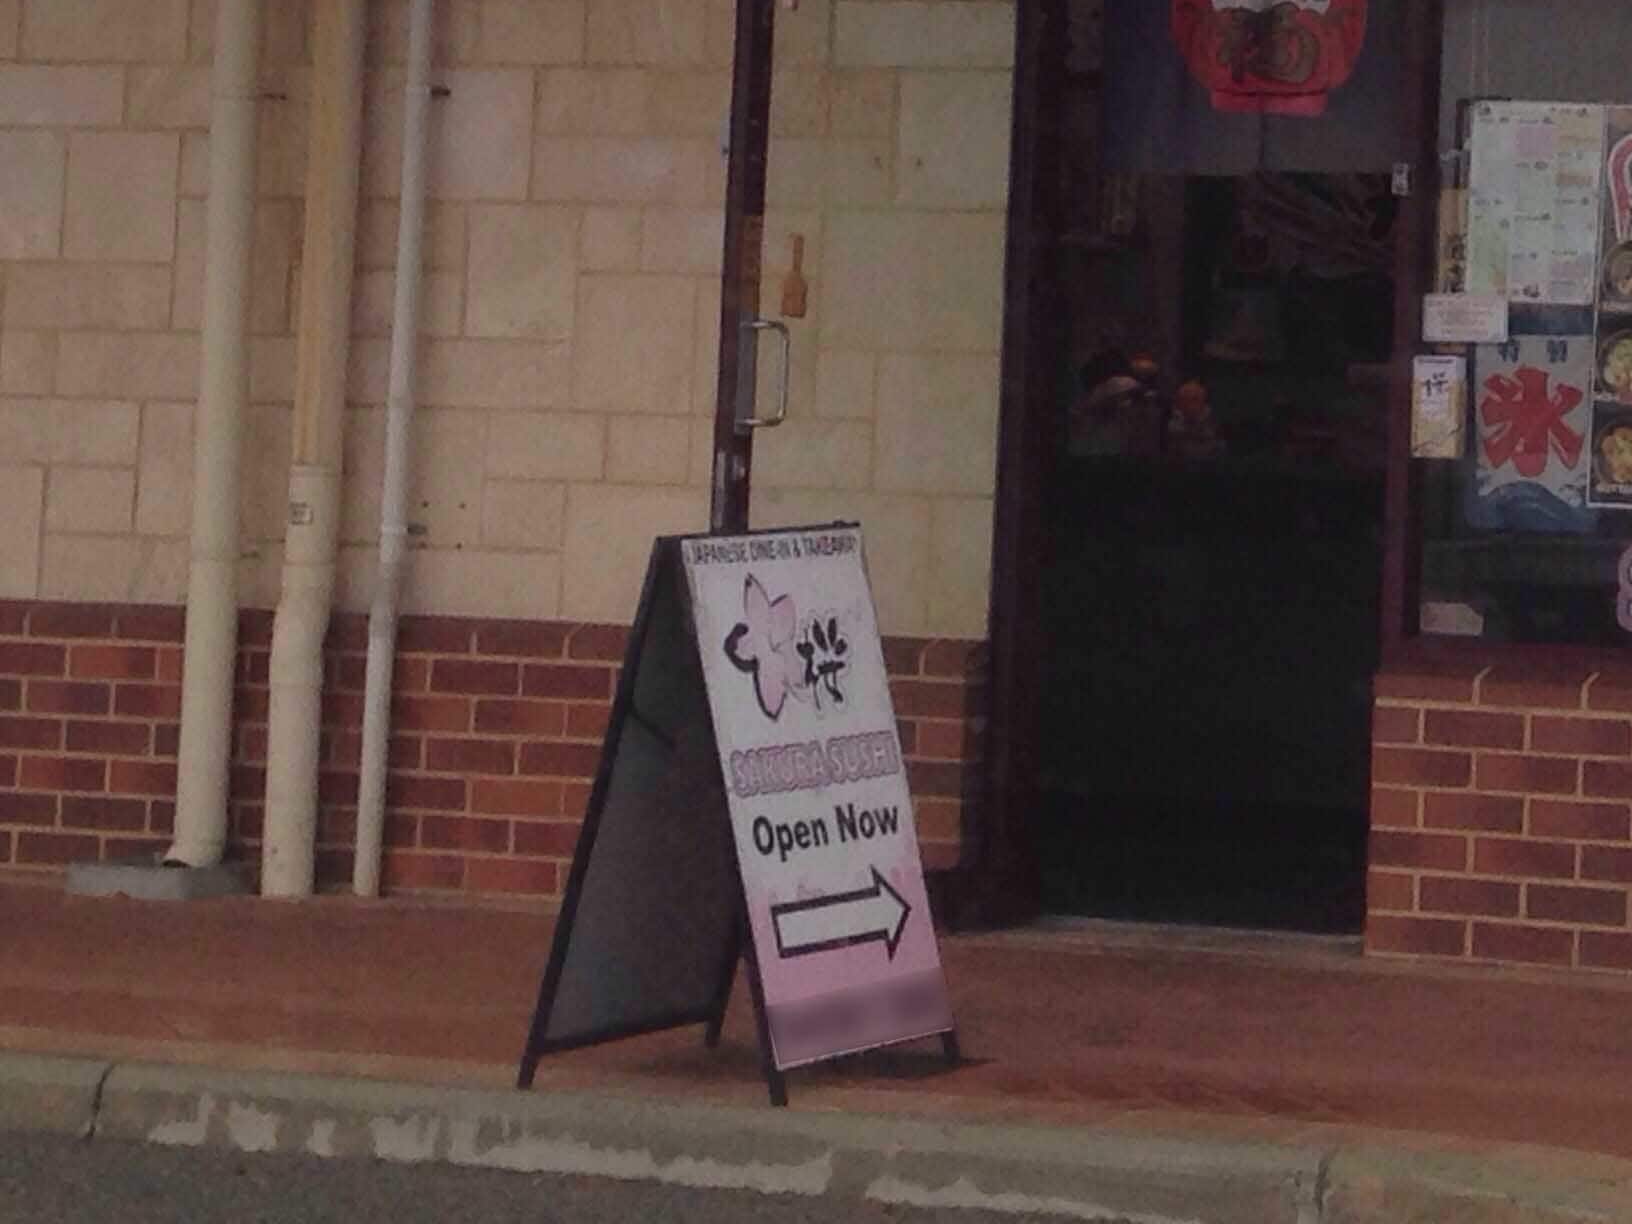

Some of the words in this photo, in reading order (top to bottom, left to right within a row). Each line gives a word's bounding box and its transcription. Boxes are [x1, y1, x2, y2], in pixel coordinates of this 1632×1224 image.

[1481, 365, 1585, 478] 氷
[732, 742, 828, 795] SAKURA
[829, 733, 898, 781] SUSHI
[752, 815, 829, 862] Open
[834, 802, 899, 843] Now
